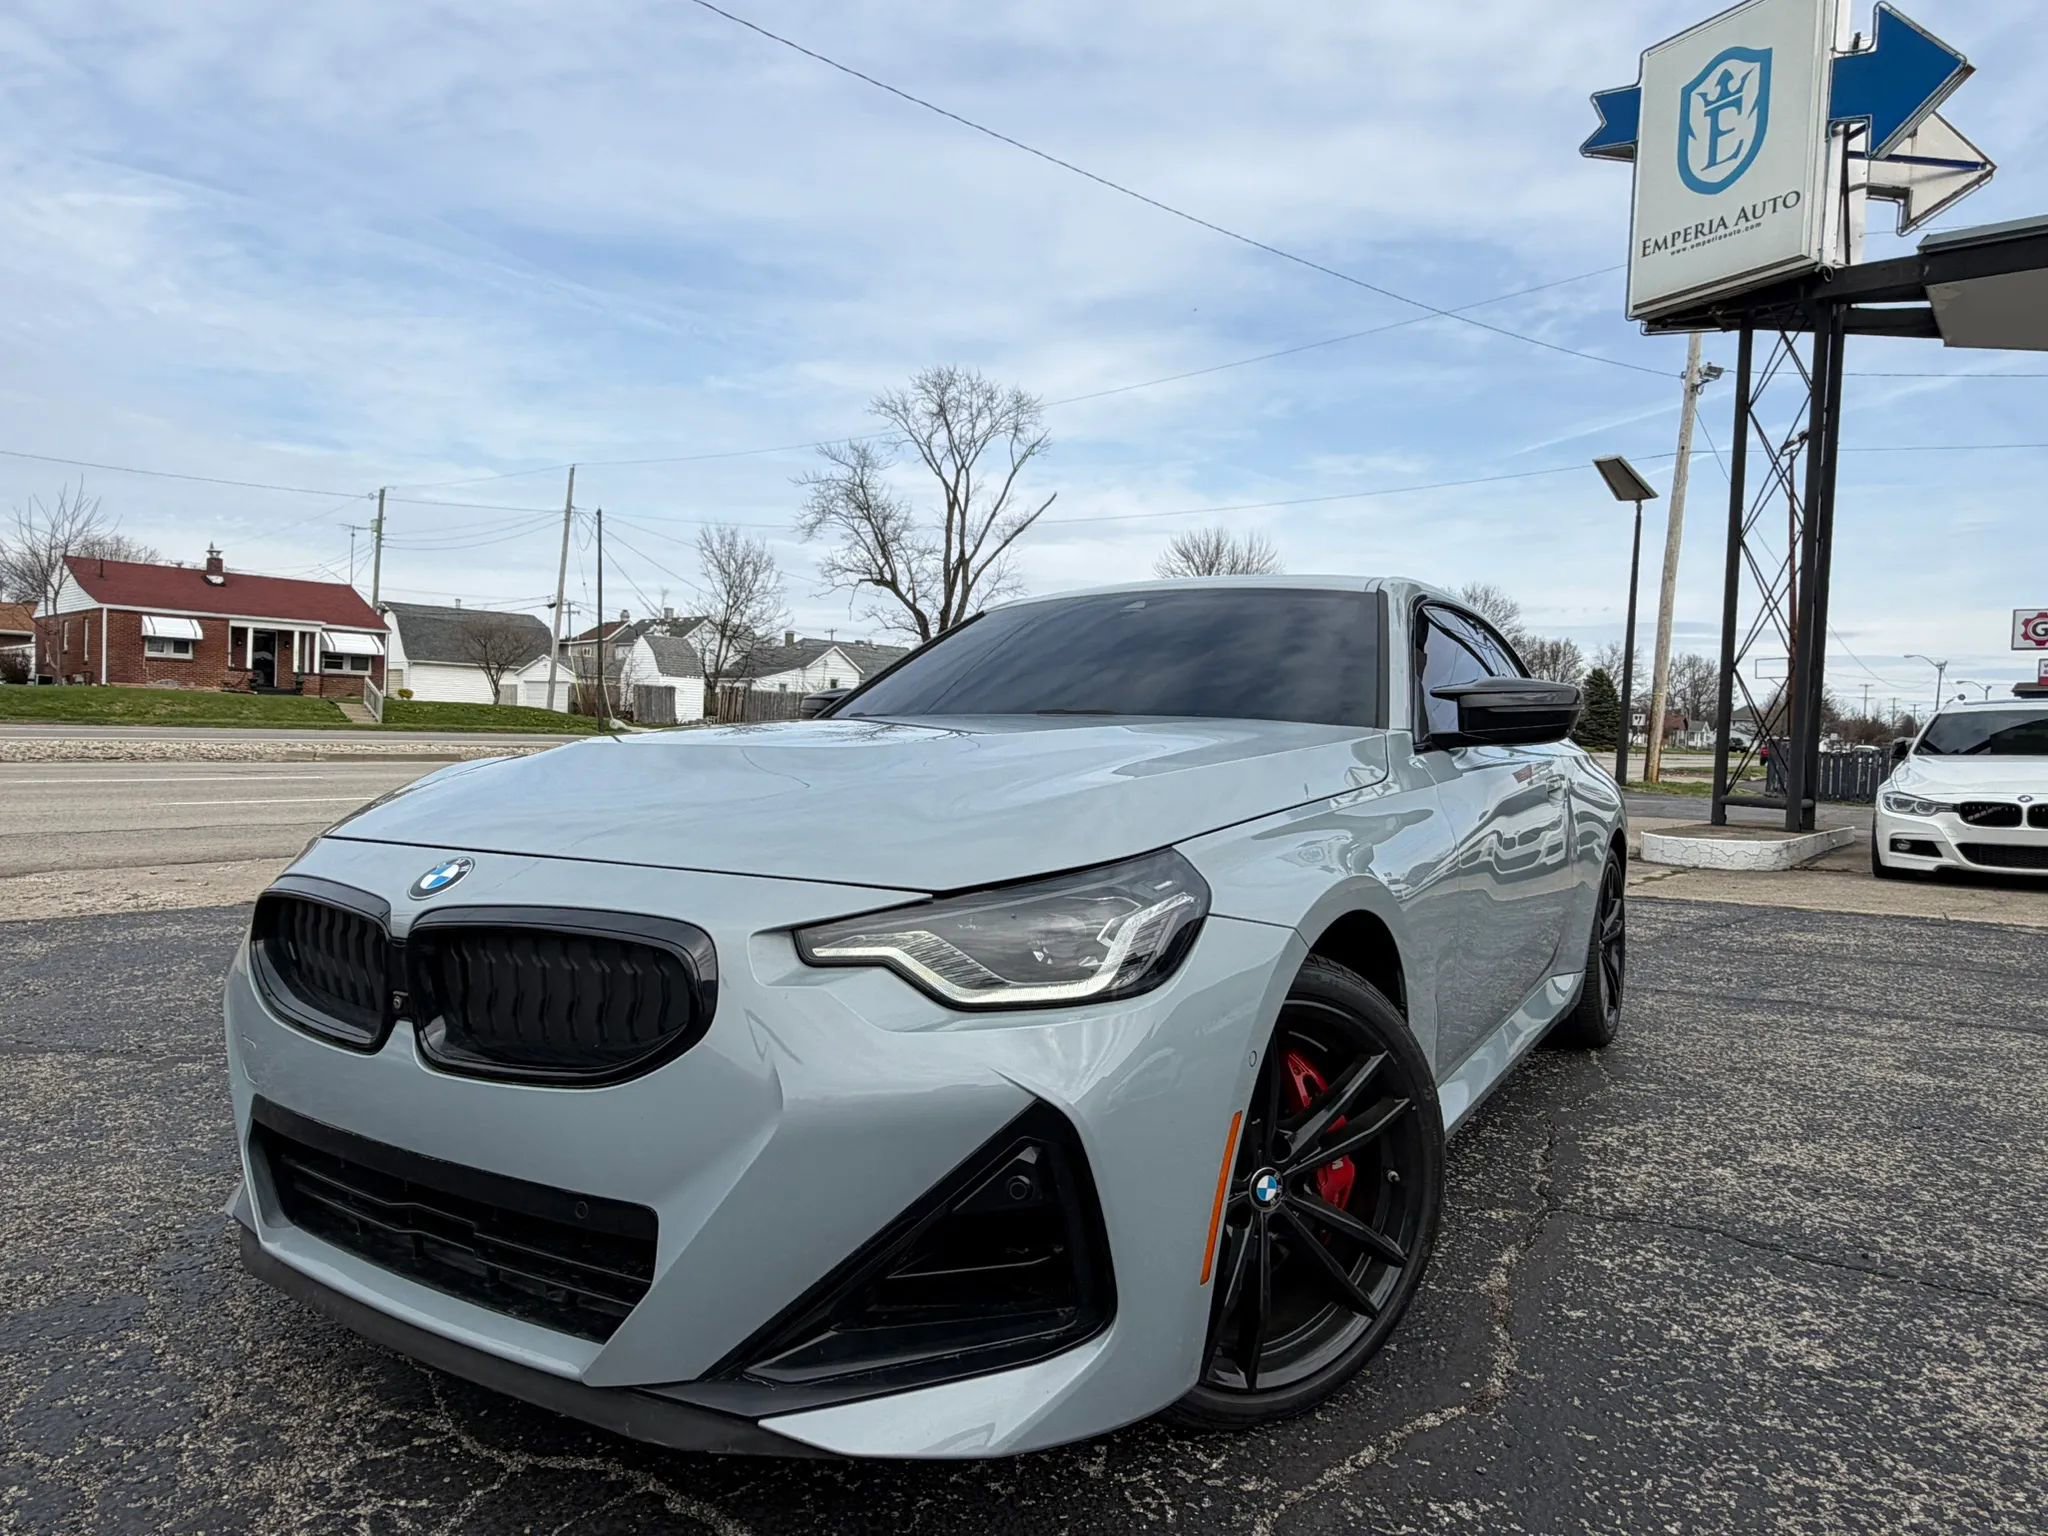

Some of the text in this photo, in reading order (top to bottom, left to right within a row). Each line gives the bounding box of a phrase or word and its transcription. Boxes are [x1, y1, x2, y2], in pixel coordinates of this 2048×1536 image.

[1700, 94, 1744, 171] E
[1641, 190, 1801, 258] EMPERIA AUTO
